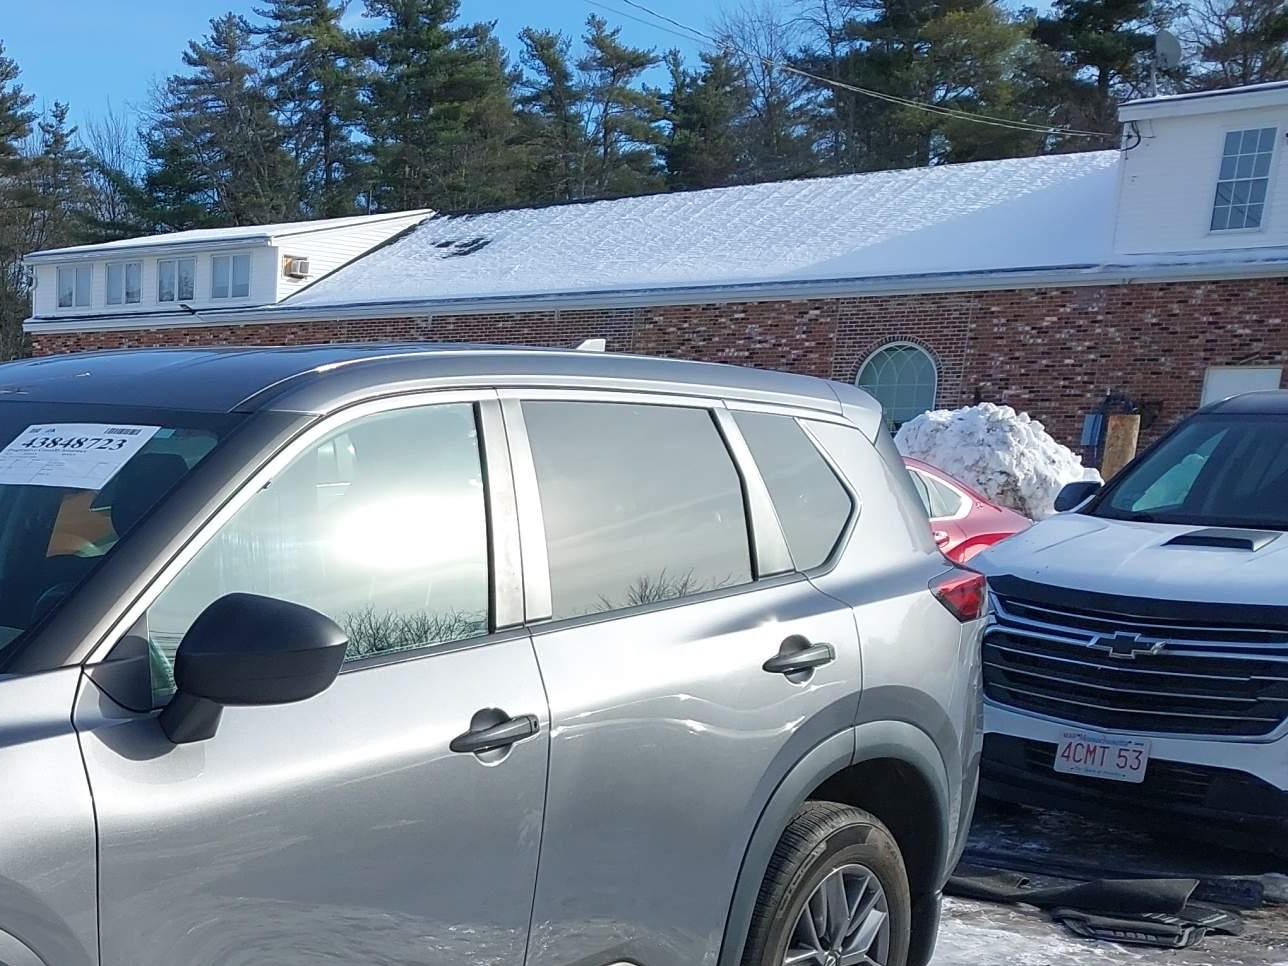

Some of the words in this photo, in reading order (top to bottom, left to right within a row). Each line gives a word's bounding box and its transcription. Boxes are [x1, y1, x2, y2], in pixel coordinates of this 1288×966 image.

[22, 437, 127, 450] 43848723
[1061, 742, 1110, 767] 4CMT
[1116, 748, 1144, 771] 53
